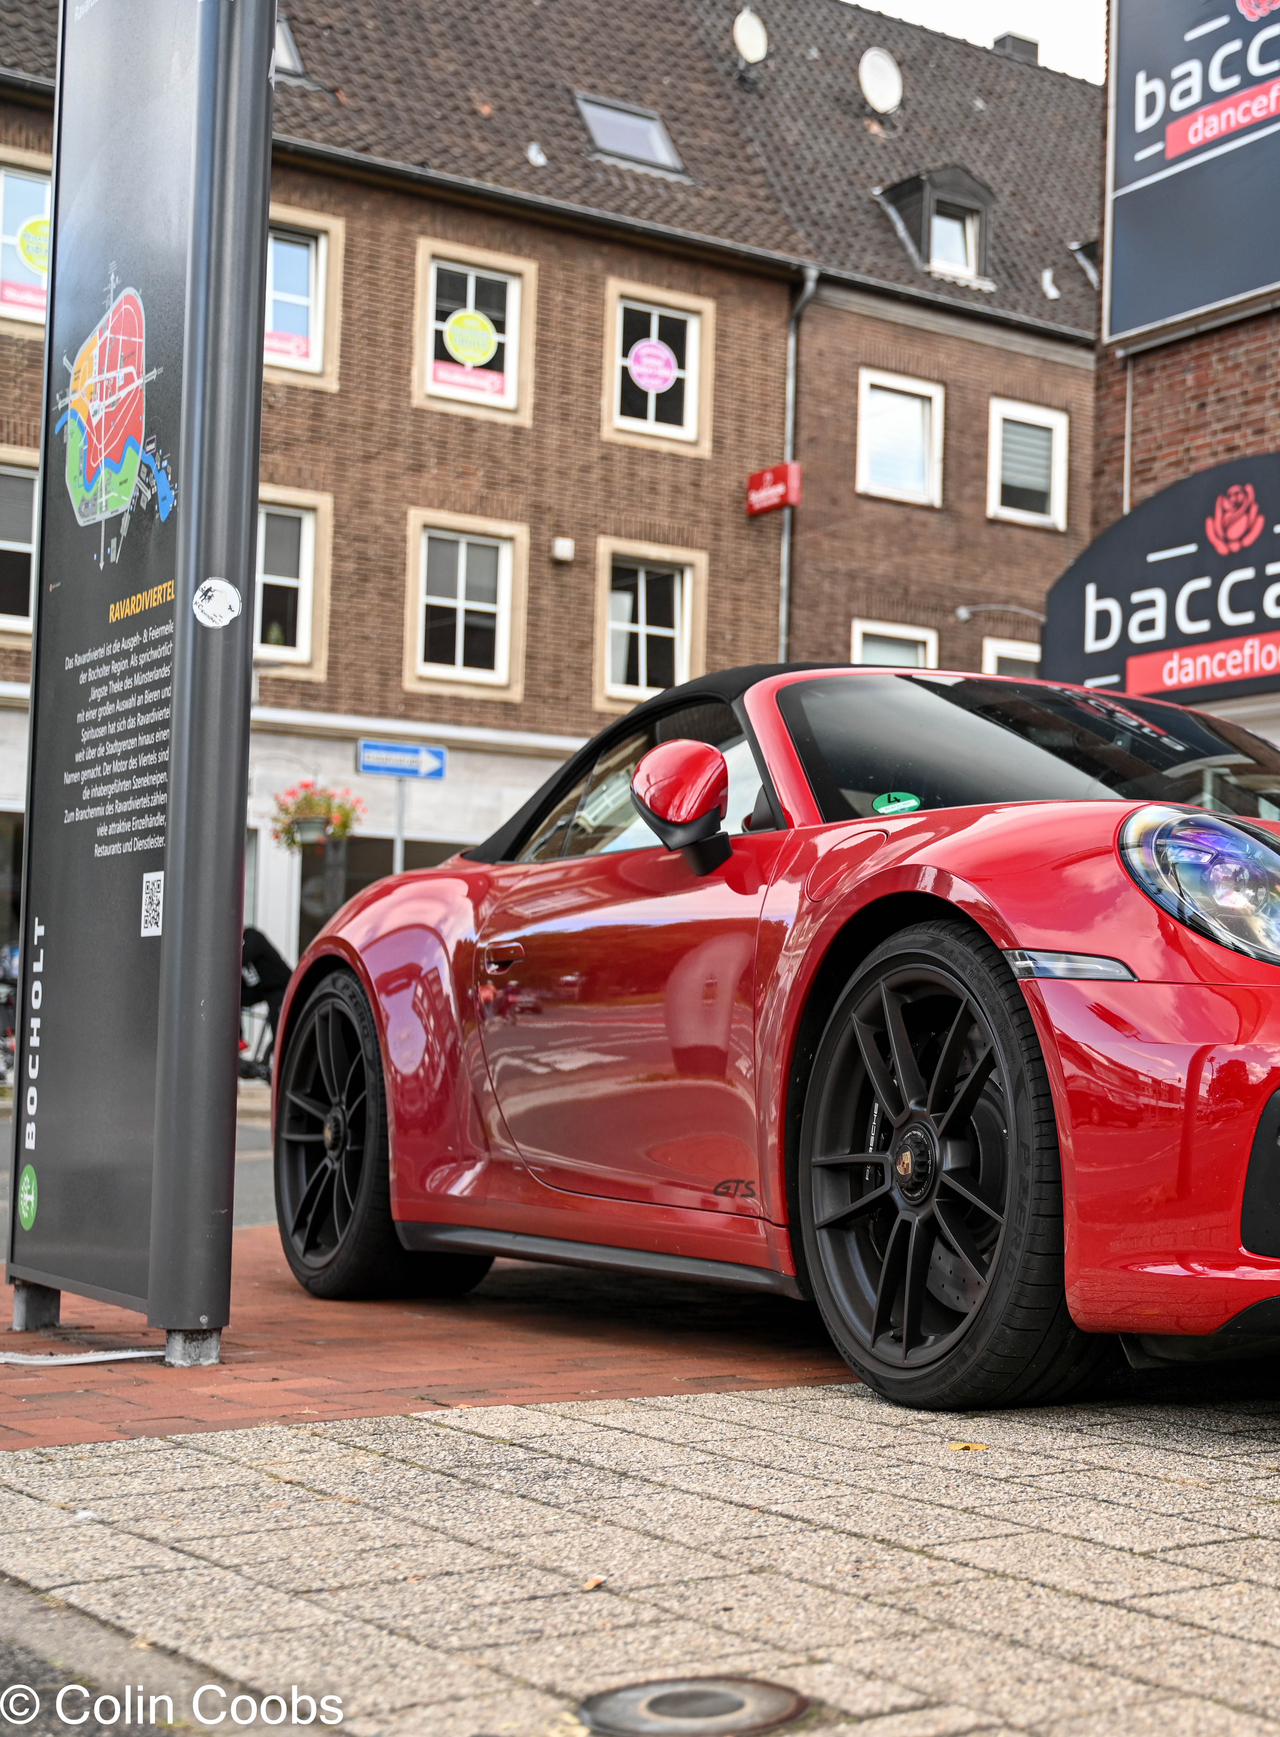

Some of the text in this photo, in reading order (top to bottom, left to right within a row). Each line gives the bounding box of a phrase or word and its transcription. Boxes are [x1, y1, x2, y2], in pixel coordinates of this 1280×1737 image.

[109, 579, 175, 624] RAVARDIVIERTEL
[65, 657, 73, 670] Das
[112, 640, 120, 654] die
[120, 632, 142, 651] Ausgeh-
[142, 629, 148, 643] &
[79, 671, 87, 684] der
[88, 664, 110, 681] Bocholter
[111, 658, 129, 676] Region.
[129, 653, 138, 667] Als
[108, 679, 123, 694] Theke
[123, 676, 132, 690] des
[85, 709, 97, 721] einer
[97, 702, 115, 721] großen
[115, 694, 136, 712] Auswahl
[136, 695, 143, 706] an
[144, 690, 160, 704] Bieren
[161, 683, 171, 699] und
[75, 749, 85, 762] weit
[85, 747, 96, 760] über
[97, 744, 105, 757] die
[138, 733, 154, 747] hinaus
[155, 728, 170, 742] einen
[81, 726, 107, 744] Spirituosen
[107, 722, 116, 734] hat
[116, 717, 126, 732] sich
[126, 716, 136, 729] das
[63, 746, 169, 785] Namen gemacht. Der Motor des Viertels sind
[64, 810, 74, 823] Zum
[75, 803, 105, 821] Branchenmix
[105, 802, 114, 815] des
[150, 791, 167, 806] zählen
[82, 786, 90, 800] die
[96, 823, 108, 836] viele
[108, 819, 131, 835] attraktive
[94, 842, 121, 857] Restaurants
[122, 838, 132, 853] und
[25, 916, 45, 1150] BOCHOLT
[713, 1179, 756, 1199] GTS
